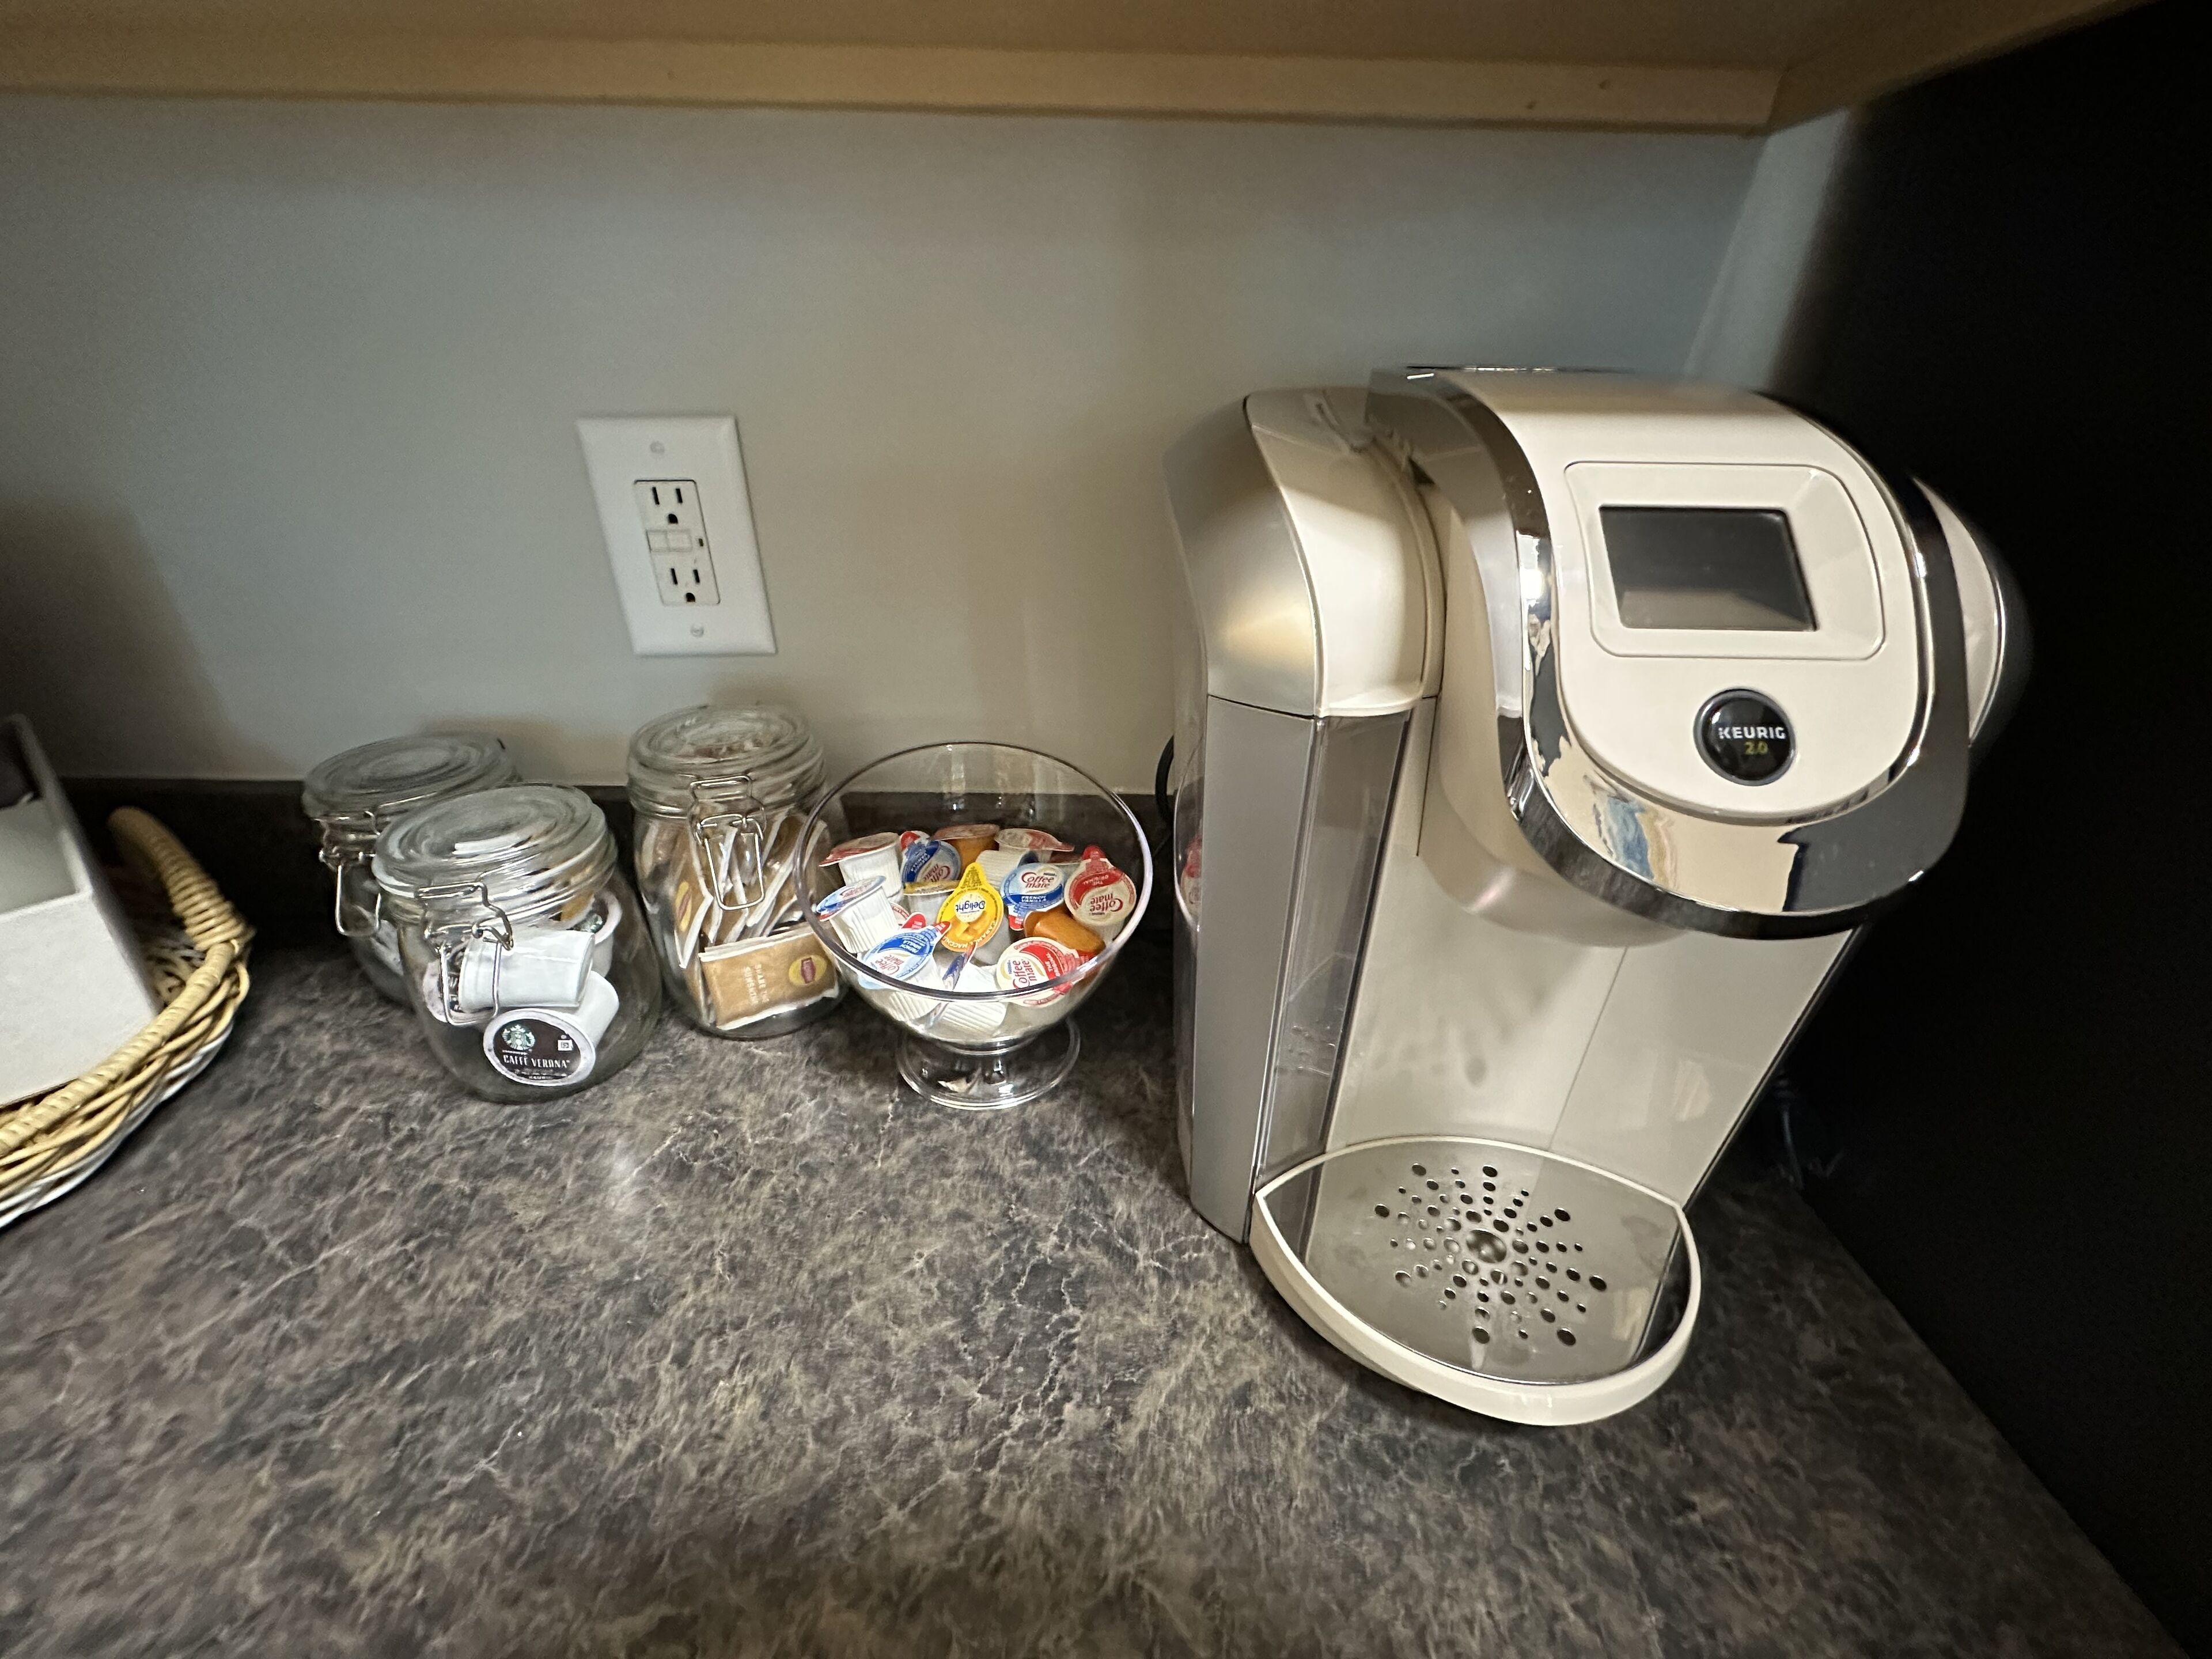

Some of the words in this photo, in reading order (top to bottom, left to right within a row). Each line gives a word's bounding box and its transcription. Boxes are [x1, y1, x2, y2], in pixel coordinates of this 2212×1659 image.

[1718, 726, 1786, 740] KEURIG
[1744, 741, 1768, 755] 2.0
[1021, 872, 1055, 884] Coffee
[955, 900, 986, 912] Delight
[1089, 898, 1123, 912] Coffee
[1090, 893, 1113, 905] mate
[875, 958, 900, 975] Coffee
[884, 955, 905, 965] mate
[1045, 961, 1054, 972] THE
[1046, 952, 1061, 977] ORIGINAL
[755, 963, 766, 988] SHARE
[1012, 960, 1031, 990] Coffee
[1022, 959, 1037, 981] mate
